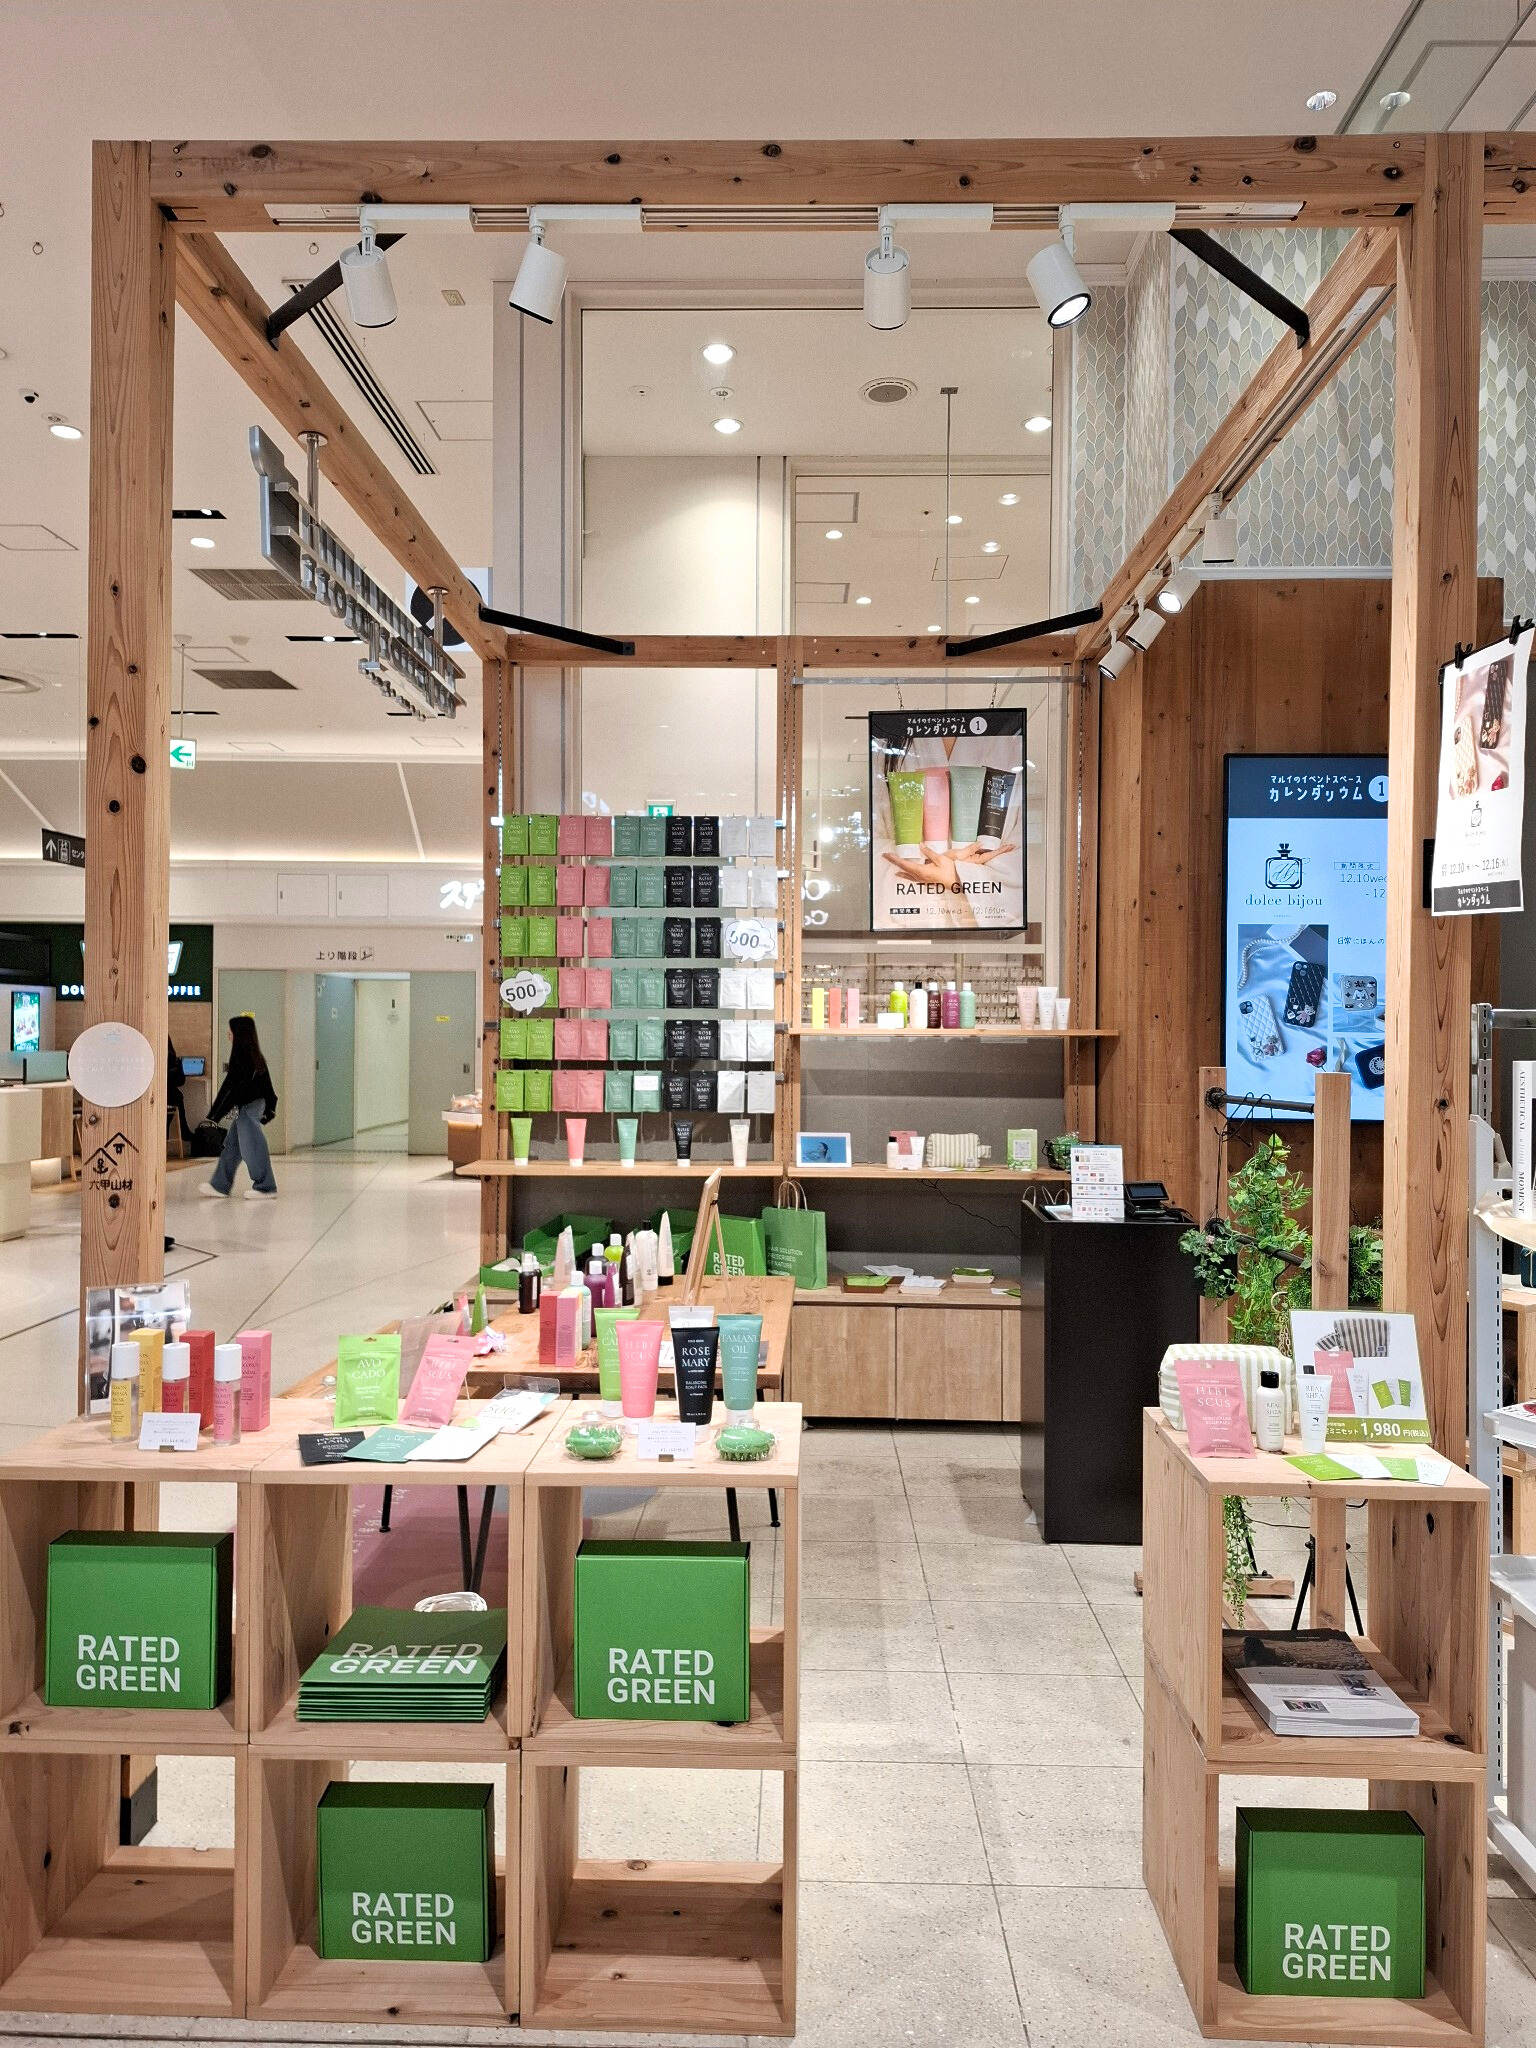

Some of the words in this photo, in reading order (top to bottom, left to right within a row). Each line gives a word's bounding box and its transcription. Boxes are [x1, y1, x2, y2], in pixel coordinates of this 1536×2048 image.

[906, 723, 967, 736] カレンダリウム
[1270, 775, 1362, 784] マルイのイベントスペース
[1269, 785, 1363, 803] カレンダリウム
[1377, 781, 1385, 797] 1
[896, 883, 945, 896] RATED
[951, 881, 1002, 894] GREEN
[1245, 894, 1282, 906] dolce
[1287, 894, 1323, 909] bijou
[316, 950, 358, 960] 上り階段
[505, 983, 537, 1003] 500
[89, 1179, 133, 1191] 六甲山材
[1518, 1172, 1526, 1213] MOMENT
[682, 1347, 710, 1356] ROSE
[731, 1344, 749, 1354] OIL
[357, 1358, 382, 1368] AVO
[681, 1357, 710, 1367] MARY
[352, 1368, 386, 1380] CADO
[426, 1370, 452, 1380] SCUS
[1195, 1386, 1229, 1397] HIBI
[1305, 1392, 1325, 1400] SHEA
[1198, 1397, 1232, 1408] SCUS
[1361, 1422, 1400, 1438] 1,980
[77, 1635, 180, 1663] RATED
[344, 1642, 483, 1660] RATED
[329, 1656, 479, 1676] GREEN
[609, 1647, 714, 1676] RATED
[76, 1666, 181, 1693] GREEN
[607, 1677, 715, 1705] GREEN
[352, 1892, 455, 1918] RATED
[351, 1920, 457, 1946] GREEN
[1284, 1923, 1391, 1951] RATED
[1282, 1952, 1392, 1981] GREEN
